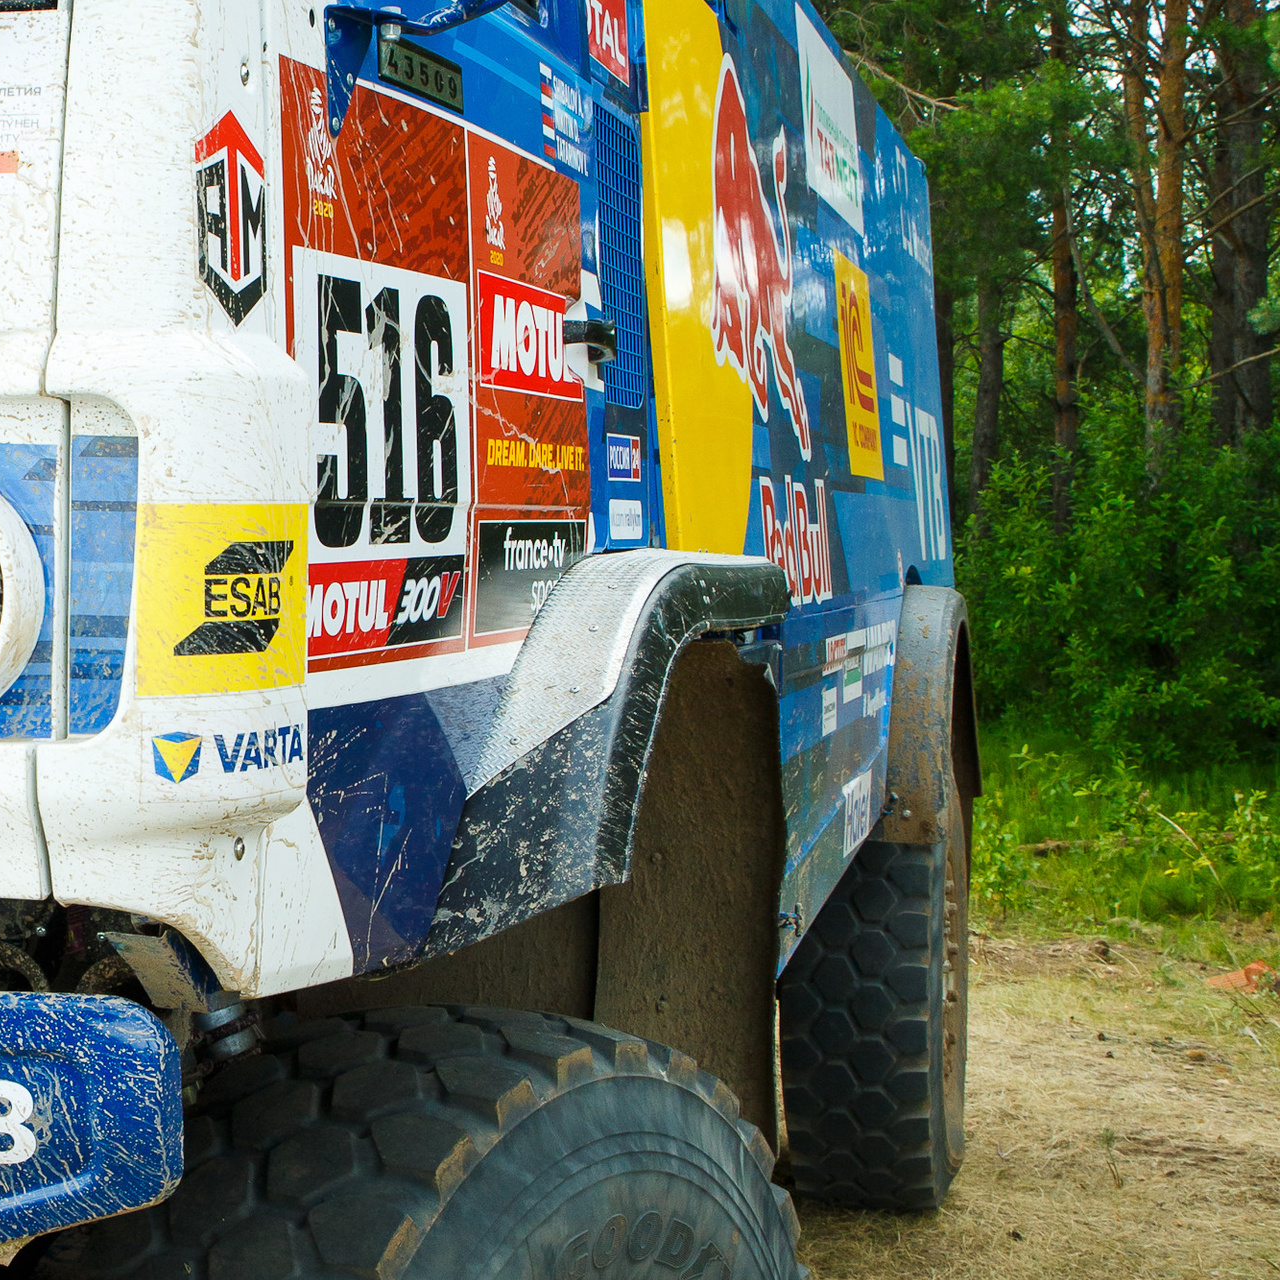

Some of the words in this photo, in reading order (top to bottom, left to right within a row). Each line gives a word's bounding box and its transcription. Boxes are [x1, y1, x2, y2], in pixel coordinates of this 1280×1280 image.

[305, 157, 338, 201] DAKAR
[313, 199, 334, 219] 2020
[485, 214, 506, 251] DAKAR
[489, 249, 504, 267] 2020
[314, 273, 458, 549] 516
[486, 438, 527, 468] DREAM.
[528, 442, 556, 470] DARE.
[556, 444, 575, 470] LIVE
[574, 446, 585, 471] IT.
[905, 401, 947, 562] VTB
[204, 576, 282, 619] ESAB
[396, 570, 461, 626] 300V
[213, 723, 304, 774] VARTA
